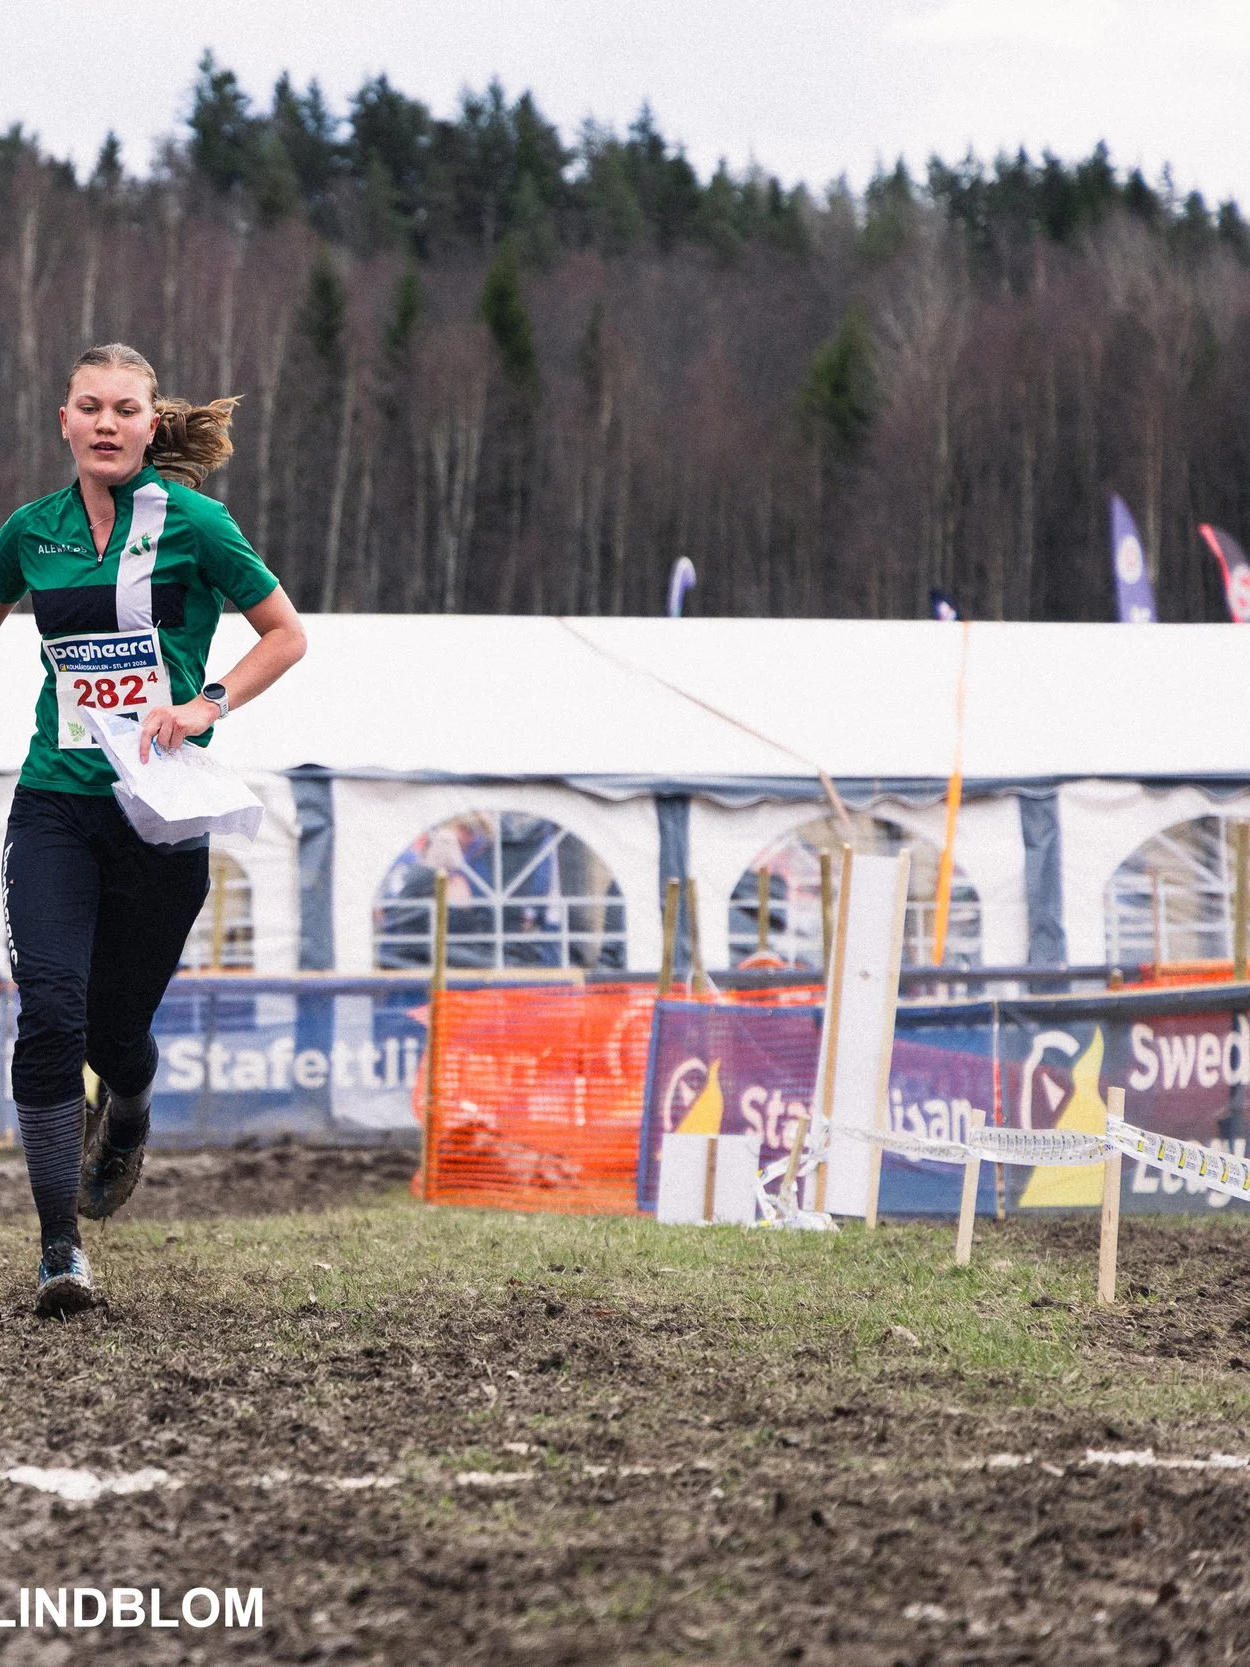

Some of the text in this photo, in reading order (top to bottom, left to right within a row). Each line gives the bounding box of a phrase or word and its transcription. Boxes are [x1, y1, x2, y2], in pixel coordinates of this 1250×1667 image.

[50, 640, 154, 662] bagheera
[147, 671, 158, 683] 4
[73, 675, 147, 709] 282
